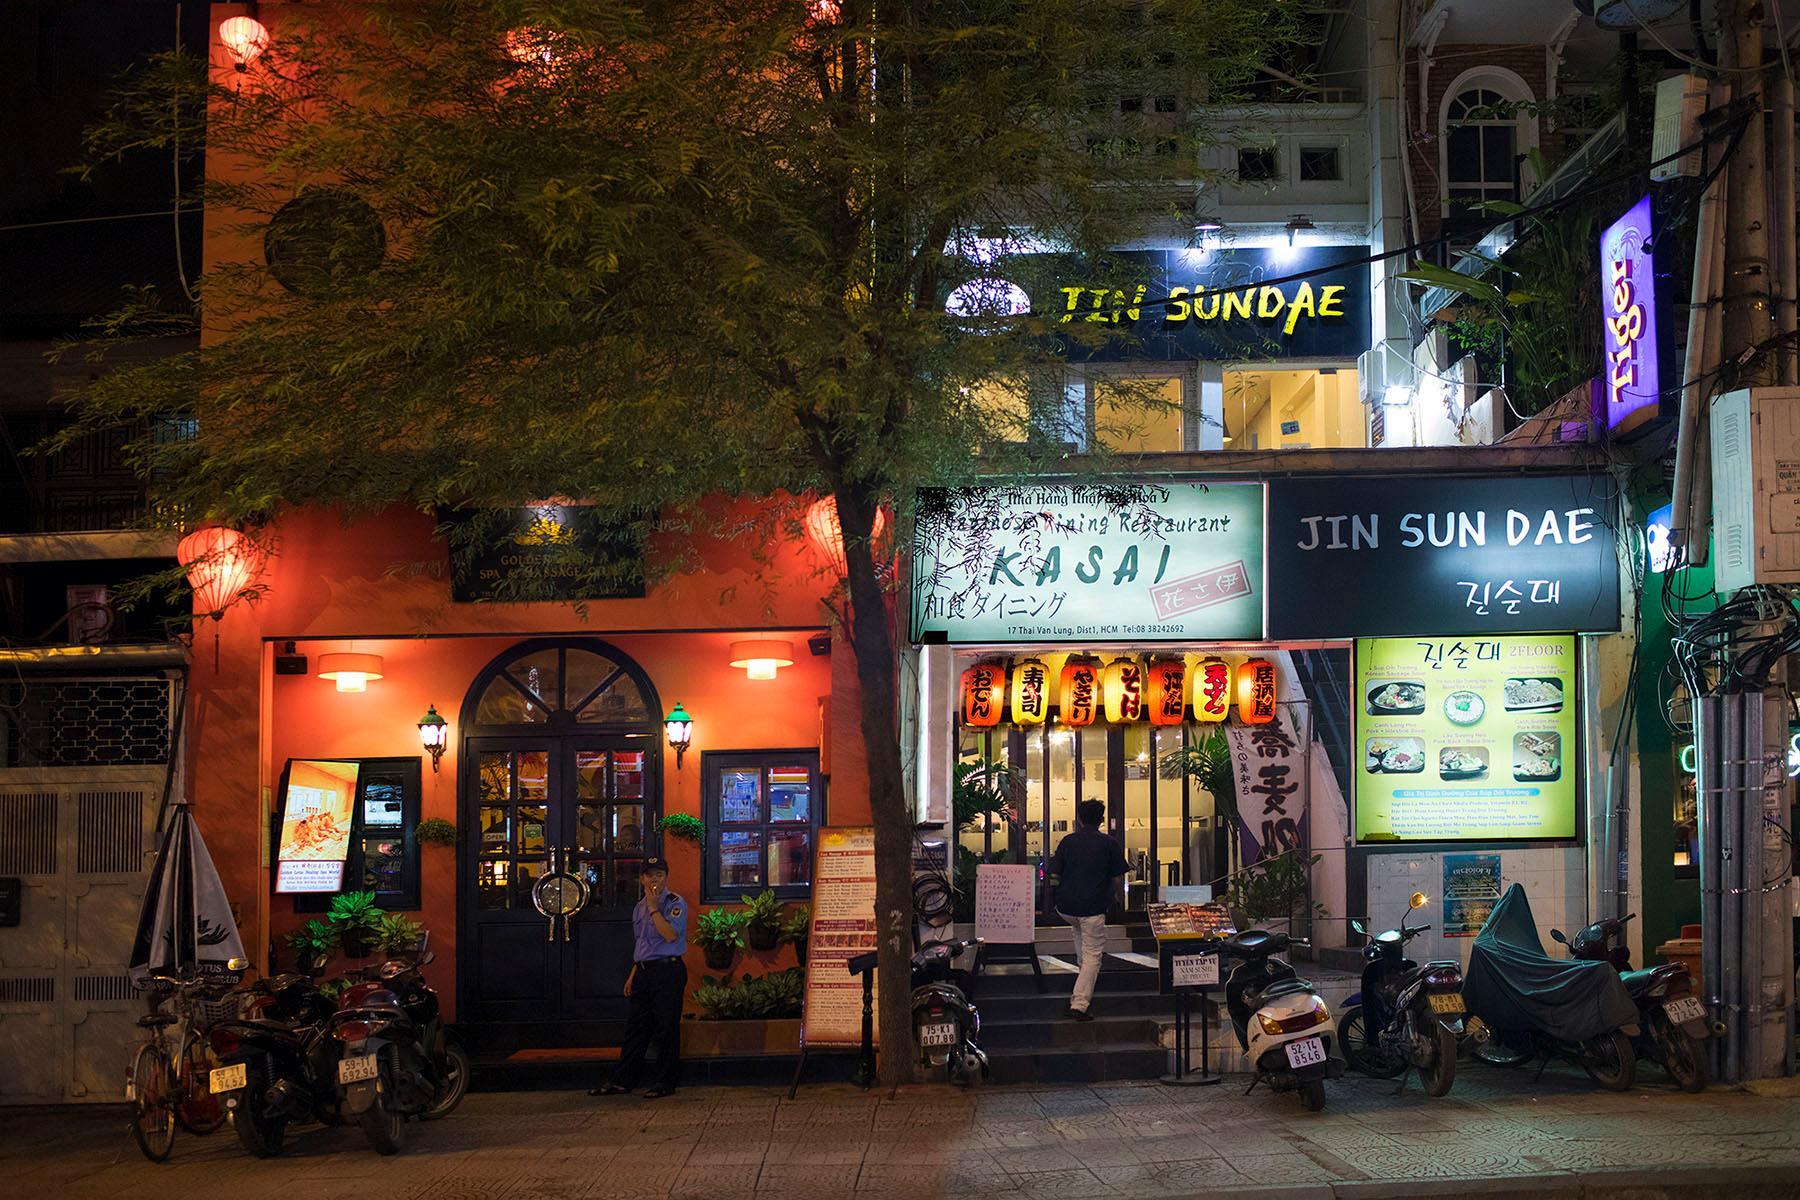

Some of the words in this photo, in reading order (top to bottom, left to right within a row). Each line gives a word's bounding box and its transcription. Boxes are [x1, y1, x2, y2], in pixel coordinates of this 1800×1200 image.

[1165, 281, 1346, 335] SUNDAE
[1606, 258, 1647, 403] Tiger
[1297, 513, 1380, 551] JIN
[1400, 511, 1486, 549] SUN
[1506, 507, 1596, 547] DAE
[988, 544, 1172, 587] KASAI
[924, 591, 1068, 621] 和食ダイニング
[1456, 578, 1561, 616] 진순대
[1007, 626, 1017, 635] 17
[1019, 626, 1036, 635] Thai
[1037, 626, 1052, 635] Van
[1053, 626, 1075, 636] Lung,
[1077, 625, 1099, 635] Dist1,
[1100, 625, 1118, 634] HCM
[1147, 624, 1185, 633] 38242692
[1508, 643, 1565, 658] 2FLOOR
[1416, 641, 1503, 670] 진순대
[971, 670, 993, 719] おでん
[1022, 667, 1045, 717] 寿司
[1073, 670, 1094, 721] やきとり
[1120, 666, 1141, 719] そば
[1253, 665, 1275, 717] 居酒屋
[1294, 1050, 1321, 1065] 8546
